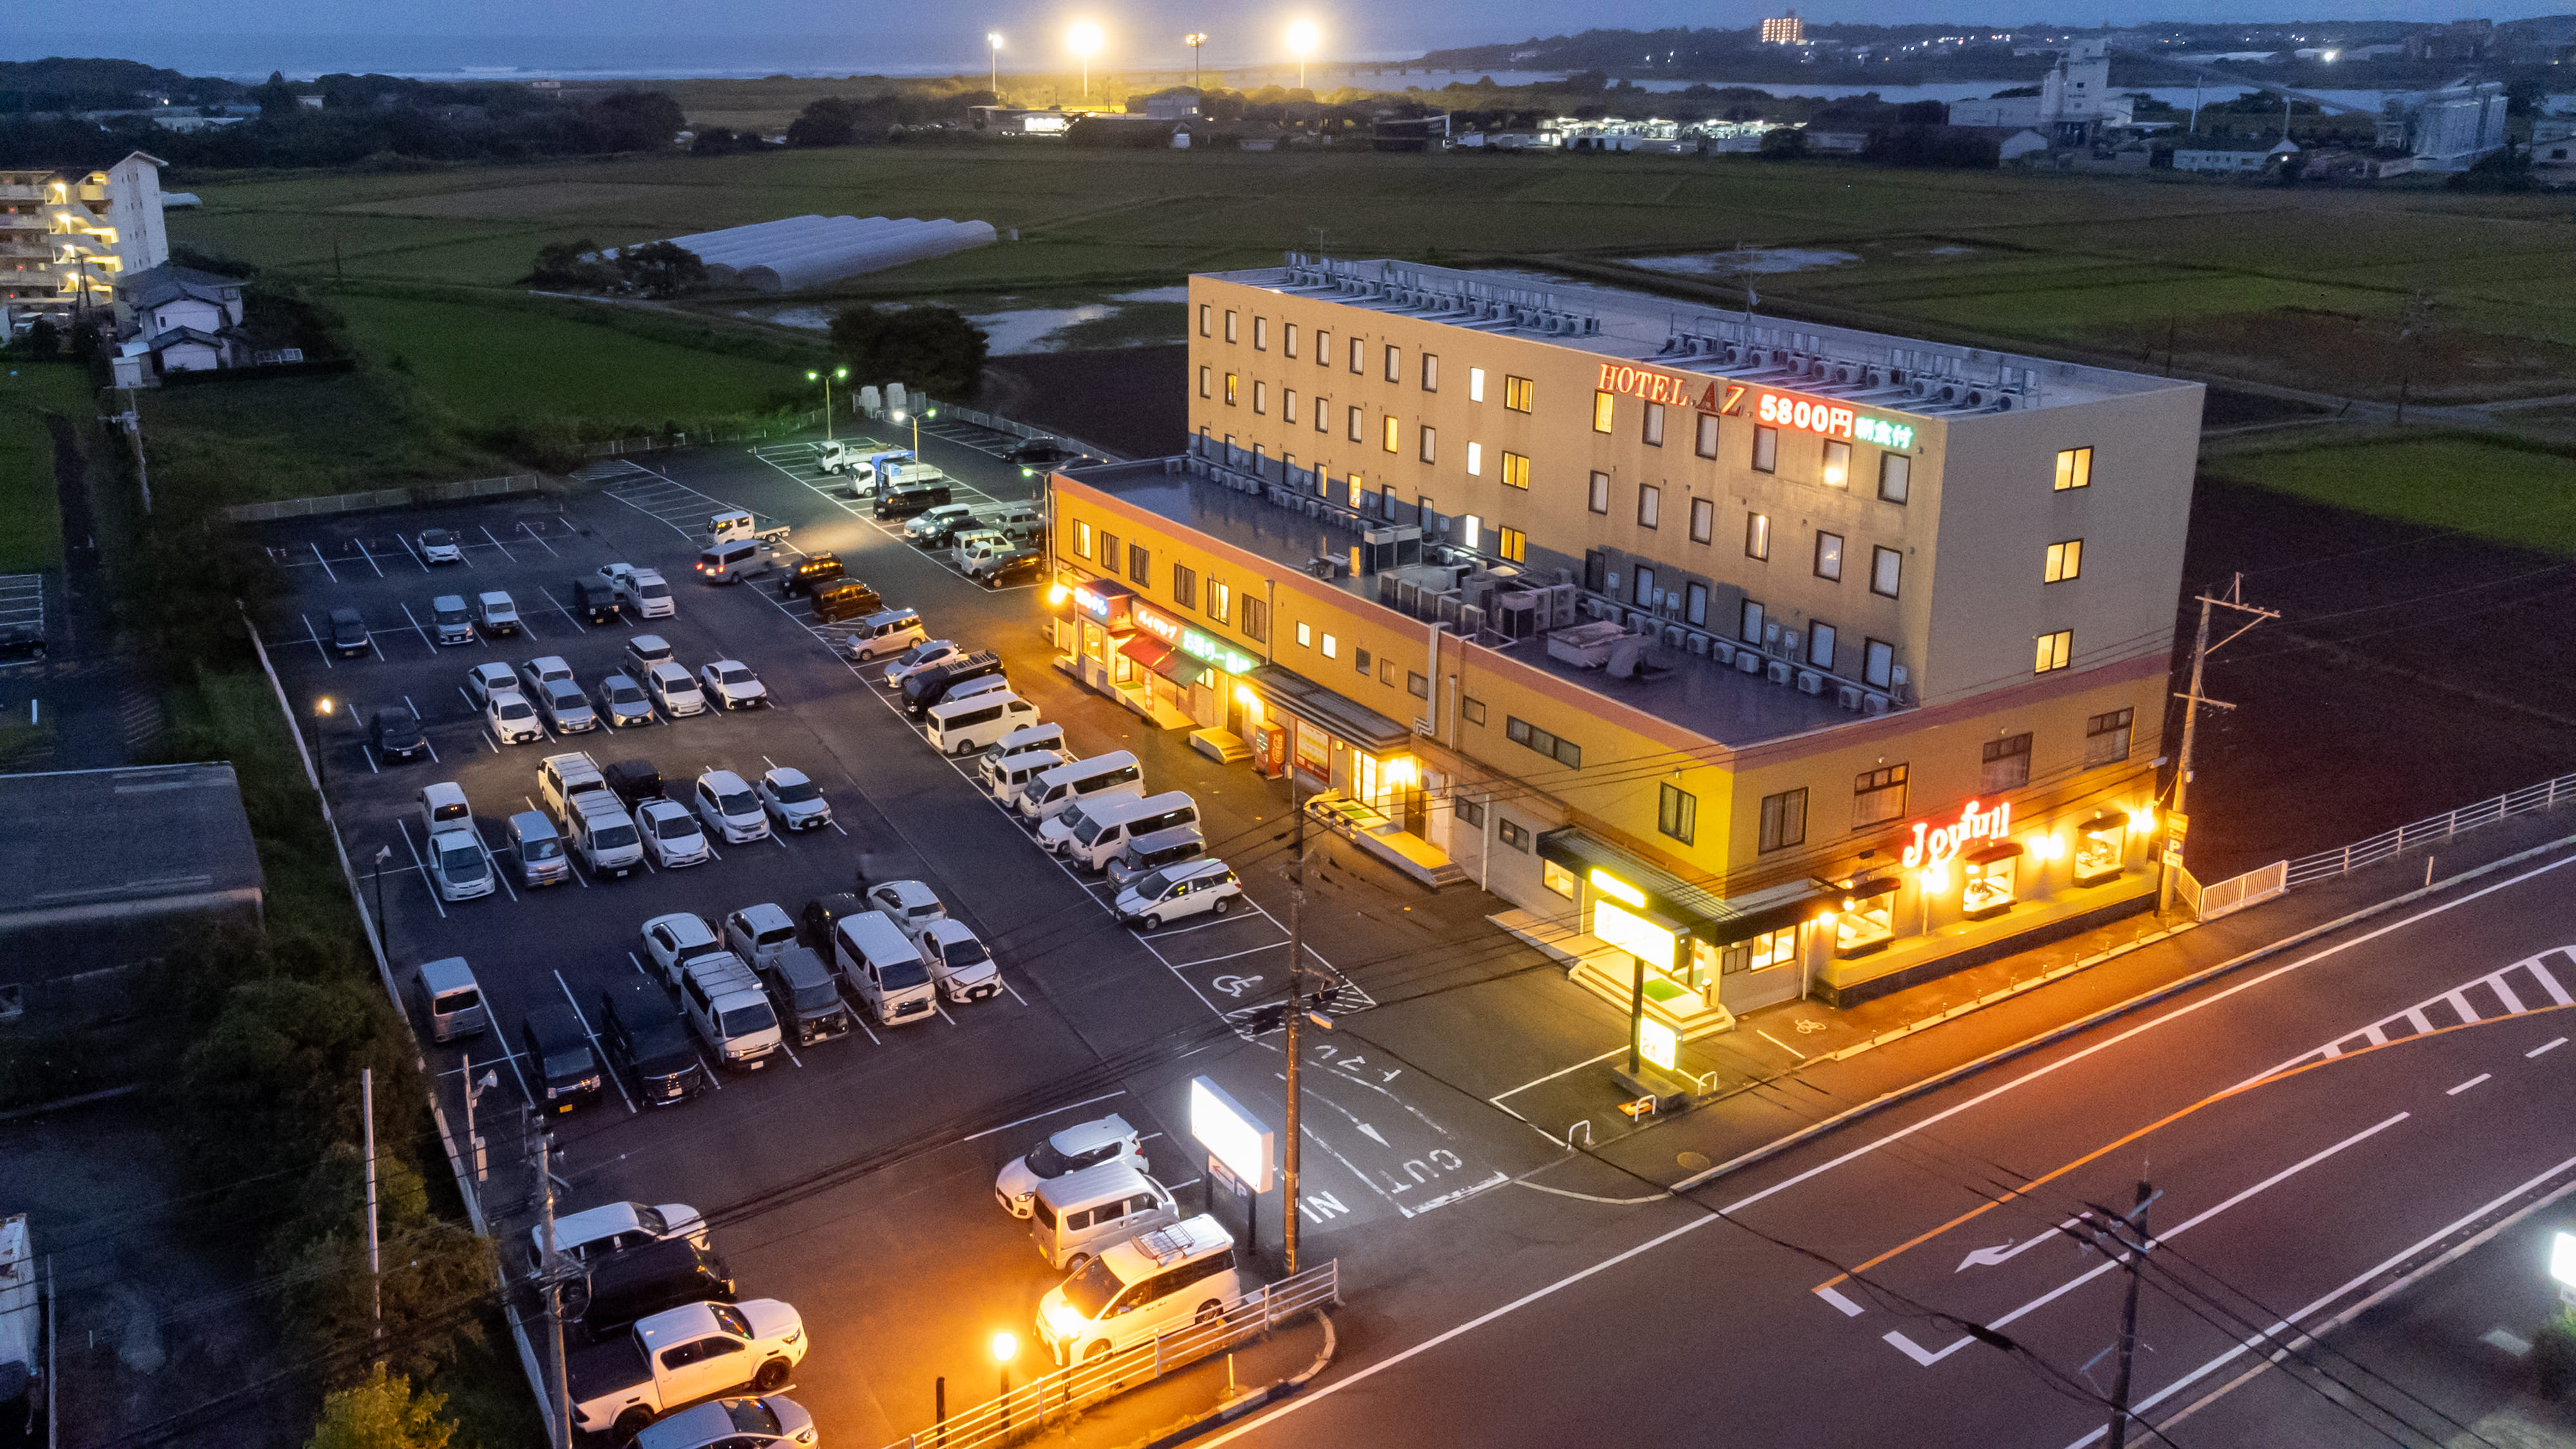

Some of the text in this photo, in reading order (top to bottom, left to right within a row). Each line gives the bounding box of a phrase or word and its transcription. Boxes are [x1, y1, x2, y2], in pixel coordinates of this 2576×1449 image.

[1597, 363, 1689, 406] HOTEL
[1696, 381, 1745, 417] AZ
[1759, 393, 1855, 437] 5800円
[1902, 800, 2011, 872] Joyfull
[2168, 839, 2181, 852] P
[1378, 1148, 1463, 1195] OUT
[1299, 1190, 1350, 1224] IN
